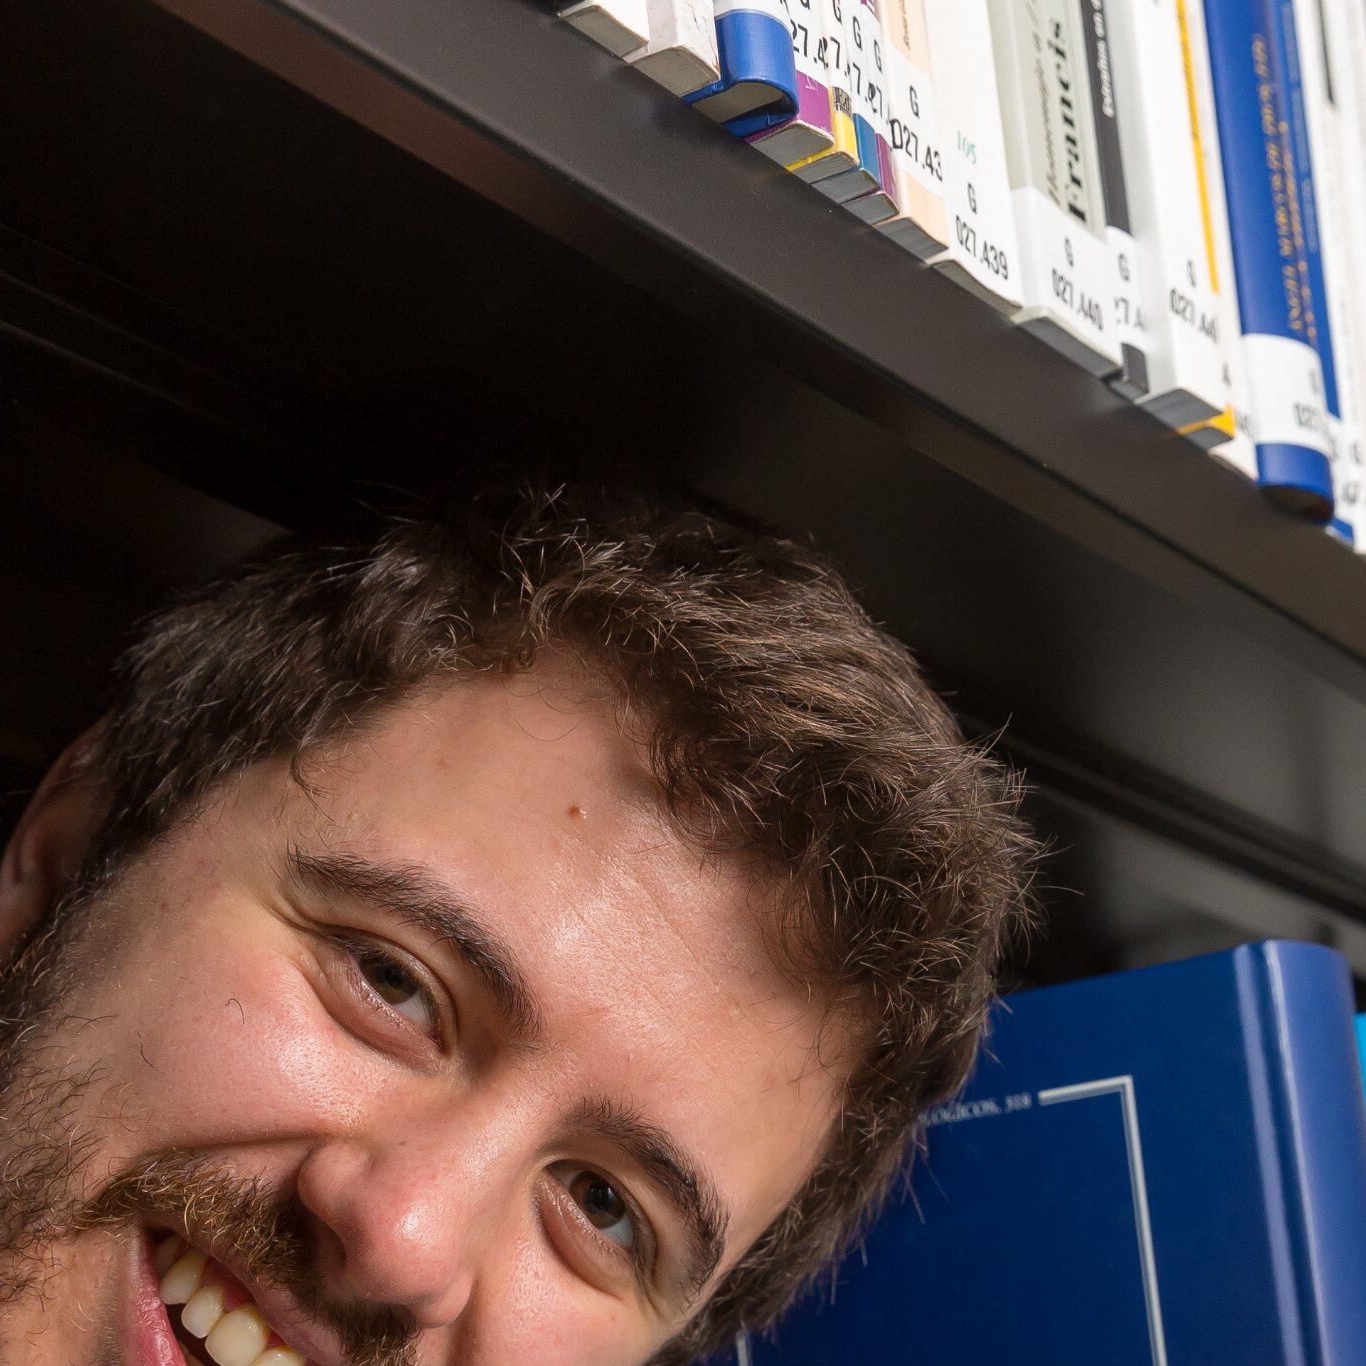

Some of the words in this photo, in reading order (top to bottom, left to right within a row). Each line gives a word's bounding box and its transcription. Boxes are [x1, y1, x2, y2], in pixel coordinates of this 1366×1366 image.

[853, 16, 862, 51] G
[874, 39, 882, 73] G
[909, 85, 920, 119] G
[967, 182, 978, 215] G
[956, 214, 1010, 281] 027.439
